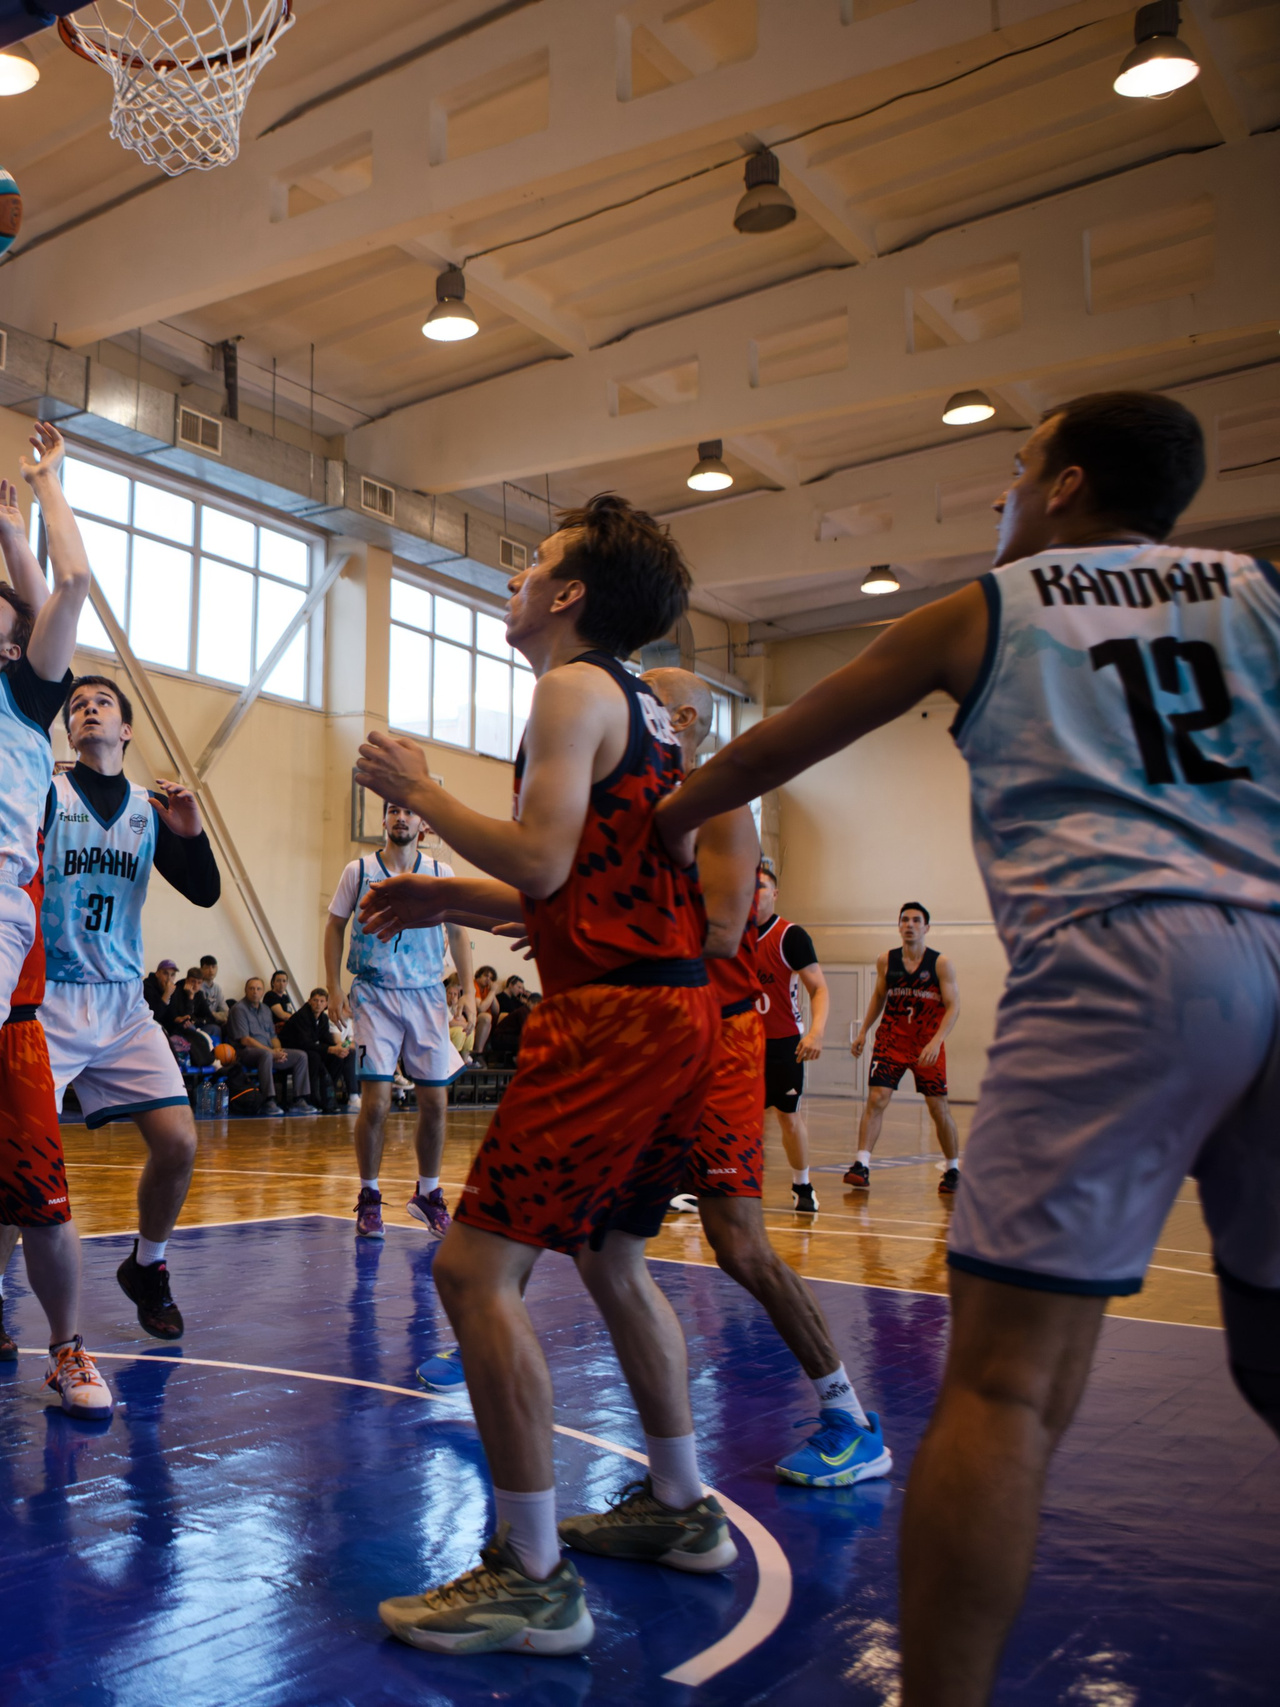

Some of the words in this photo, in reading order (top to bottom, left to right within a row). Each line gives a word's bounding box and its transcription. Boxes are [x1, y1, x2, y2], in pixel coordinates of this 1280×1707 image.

[1031, 561, 1232, 608] КАПЛАН
[1088, 636, 1254, 786] 12
[59, 811, 90, 823] fruitit
[85, 894, 114, 933] 31
[906, 1006, 914, 1024] 7
[359, 1045, 367, 1069] 7
[871, 1061, 879, 1078] 7
